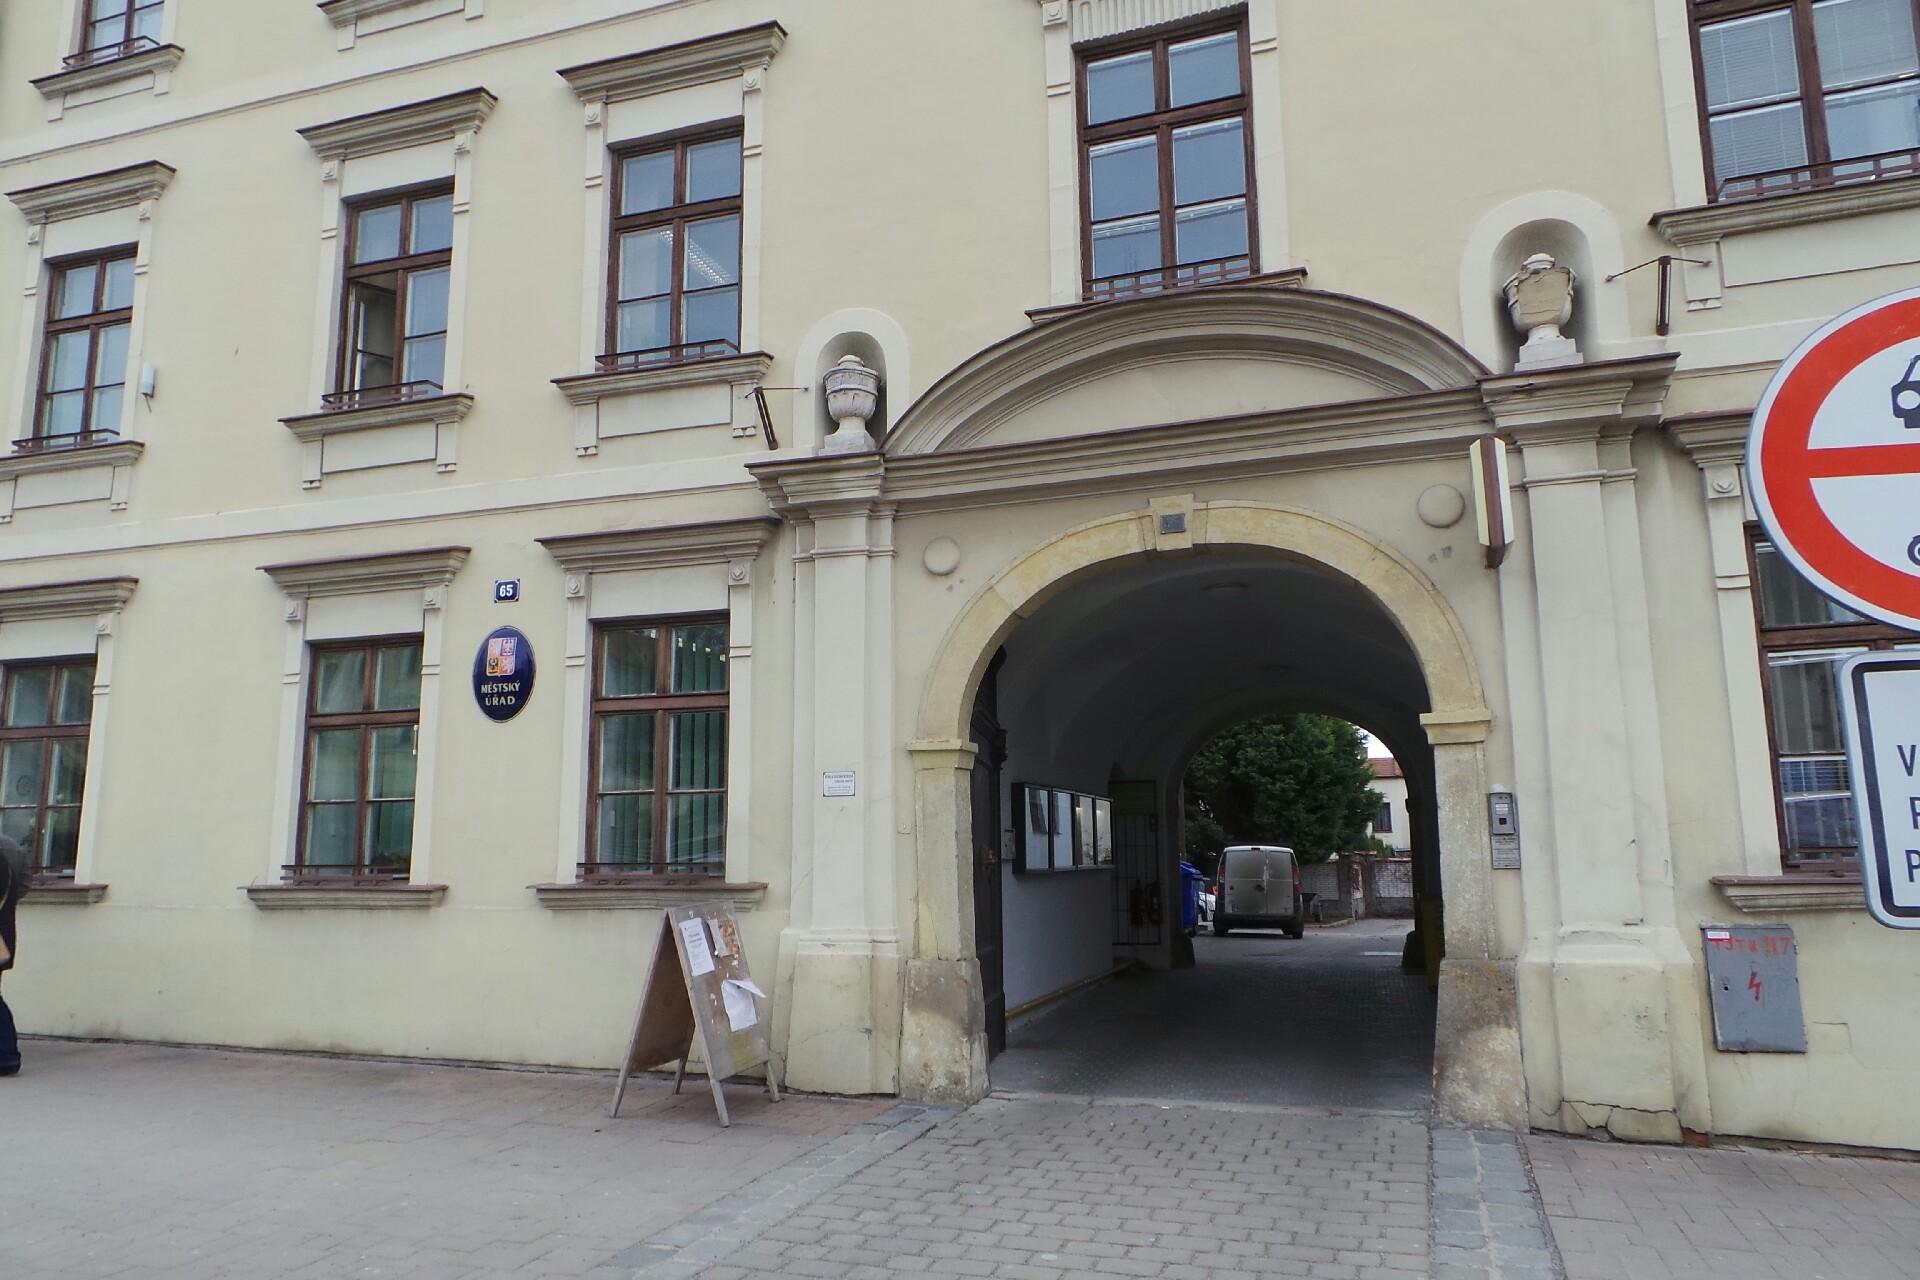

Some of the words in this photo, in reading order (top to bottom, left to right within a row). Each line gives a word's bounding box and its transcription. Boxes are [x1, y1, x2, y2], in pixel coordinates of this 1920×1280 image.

[499, 584, 513, 597] 65
[481, 680, 520, 694] MĚSTSKÝ
[485, 694, 516, 706] ÚŘAD
